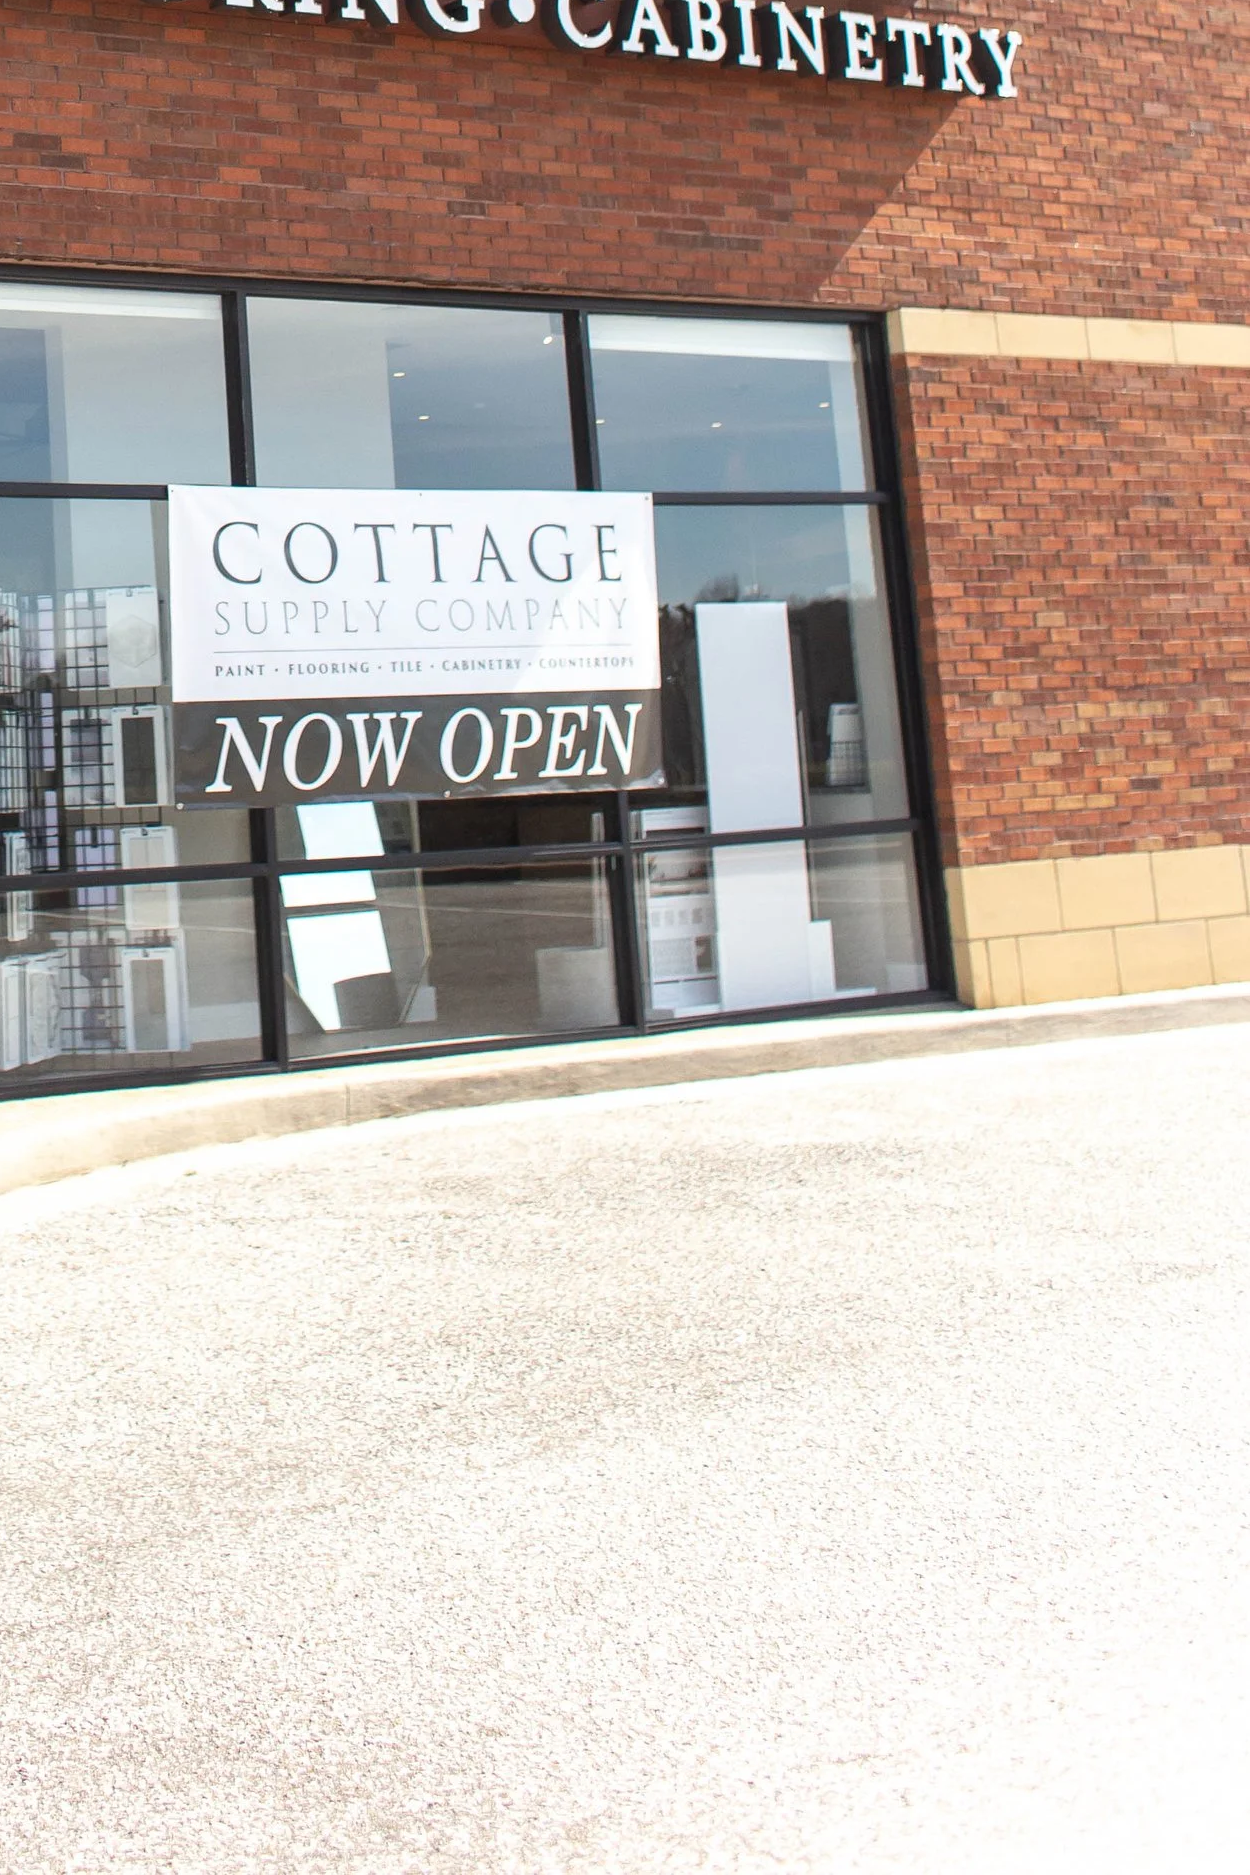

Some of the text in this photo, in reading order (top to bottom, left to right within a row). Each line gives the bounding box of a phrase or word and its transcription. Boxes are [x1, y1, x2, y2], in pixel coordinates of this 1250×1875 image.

[212, 521, 623, 585] COTTAGE
[214, 597, 628, 636] SUPPLY COMPANY
[215, 664, 265, 677] PAINT
[288, 661, 370, 675] FLOORING
[391, 660, 423, 673] TILE
[442, 658, 521, 672] CABINETRY
[205, 703, 643, 794] NOW OPEN
